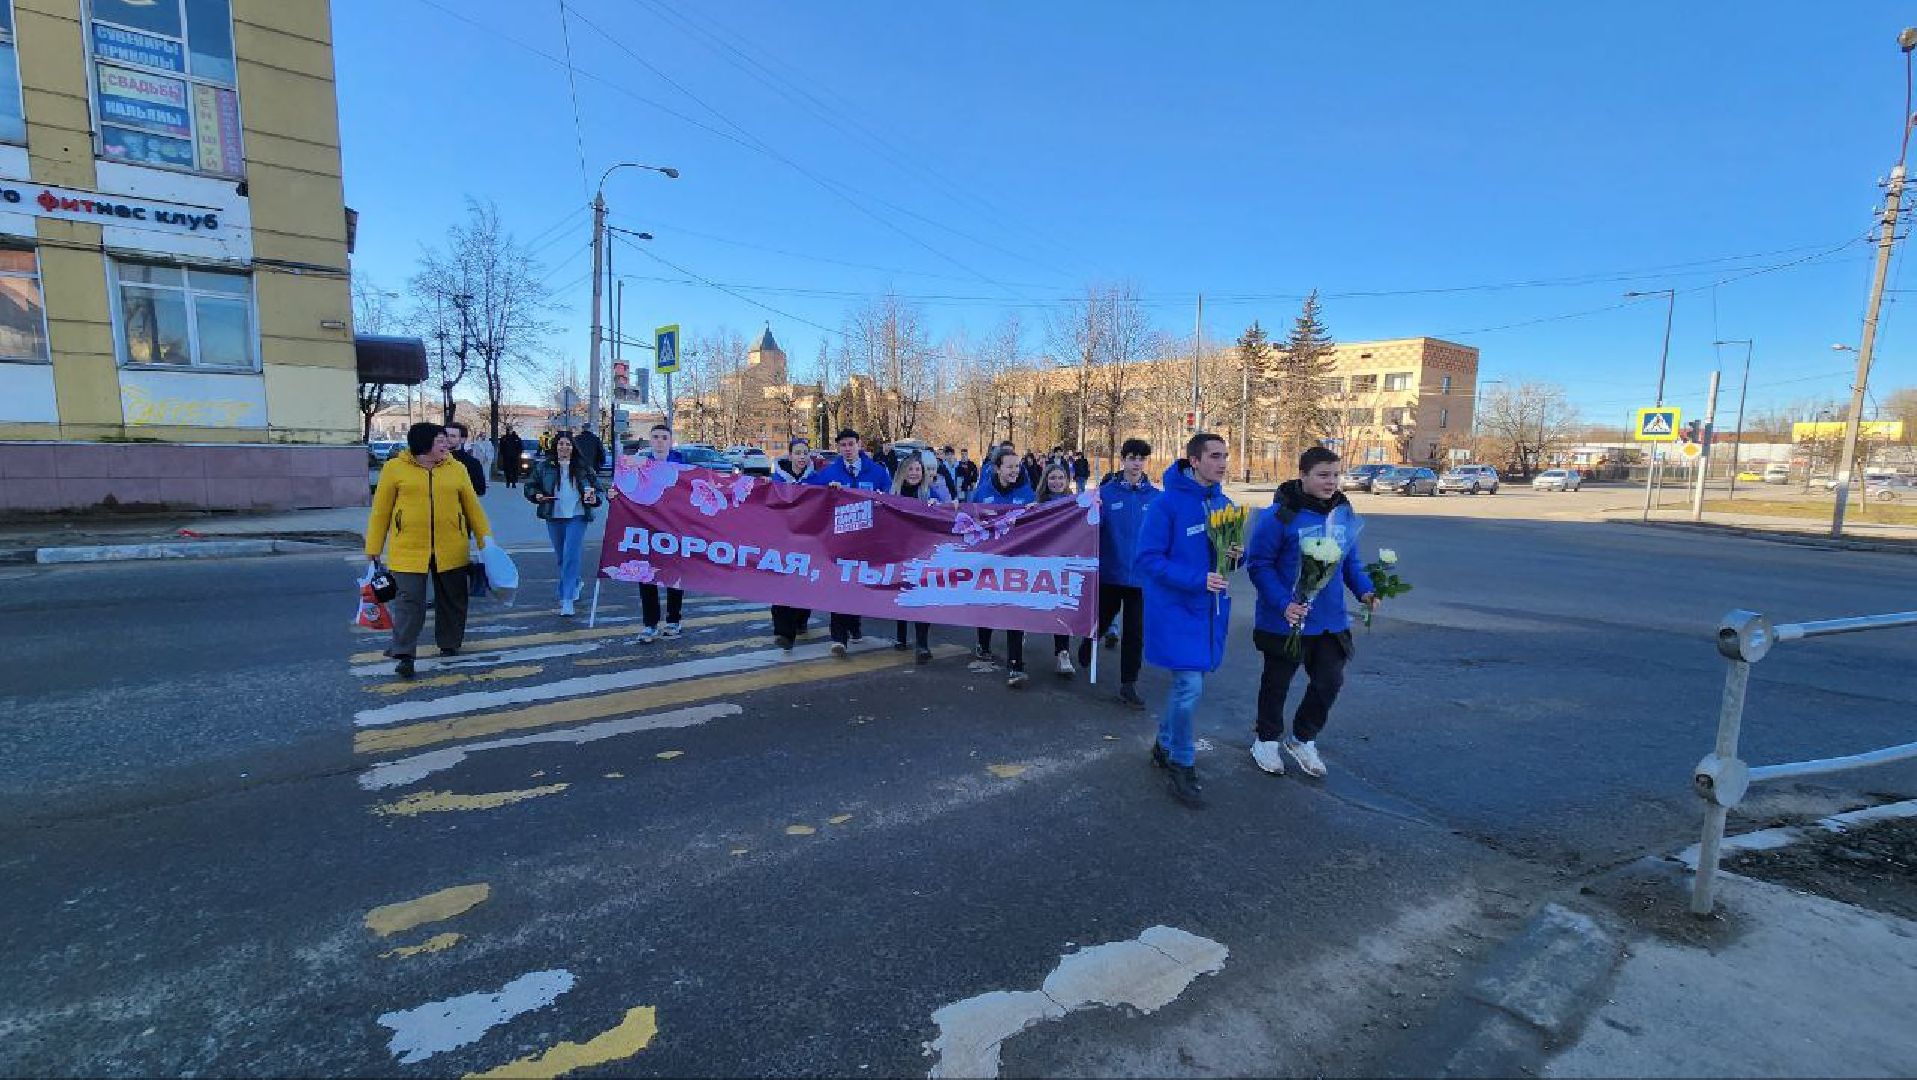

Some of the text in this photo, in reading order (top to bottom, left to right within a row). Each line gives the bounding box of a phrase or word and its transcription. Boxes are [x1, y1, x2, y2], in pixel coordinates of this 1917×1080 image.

[108, 72, 182, 99] СВАДЬБЫ
[617, 526, 1070, 597] ДОРОГАЯ, ТЫ ПРАВА!
